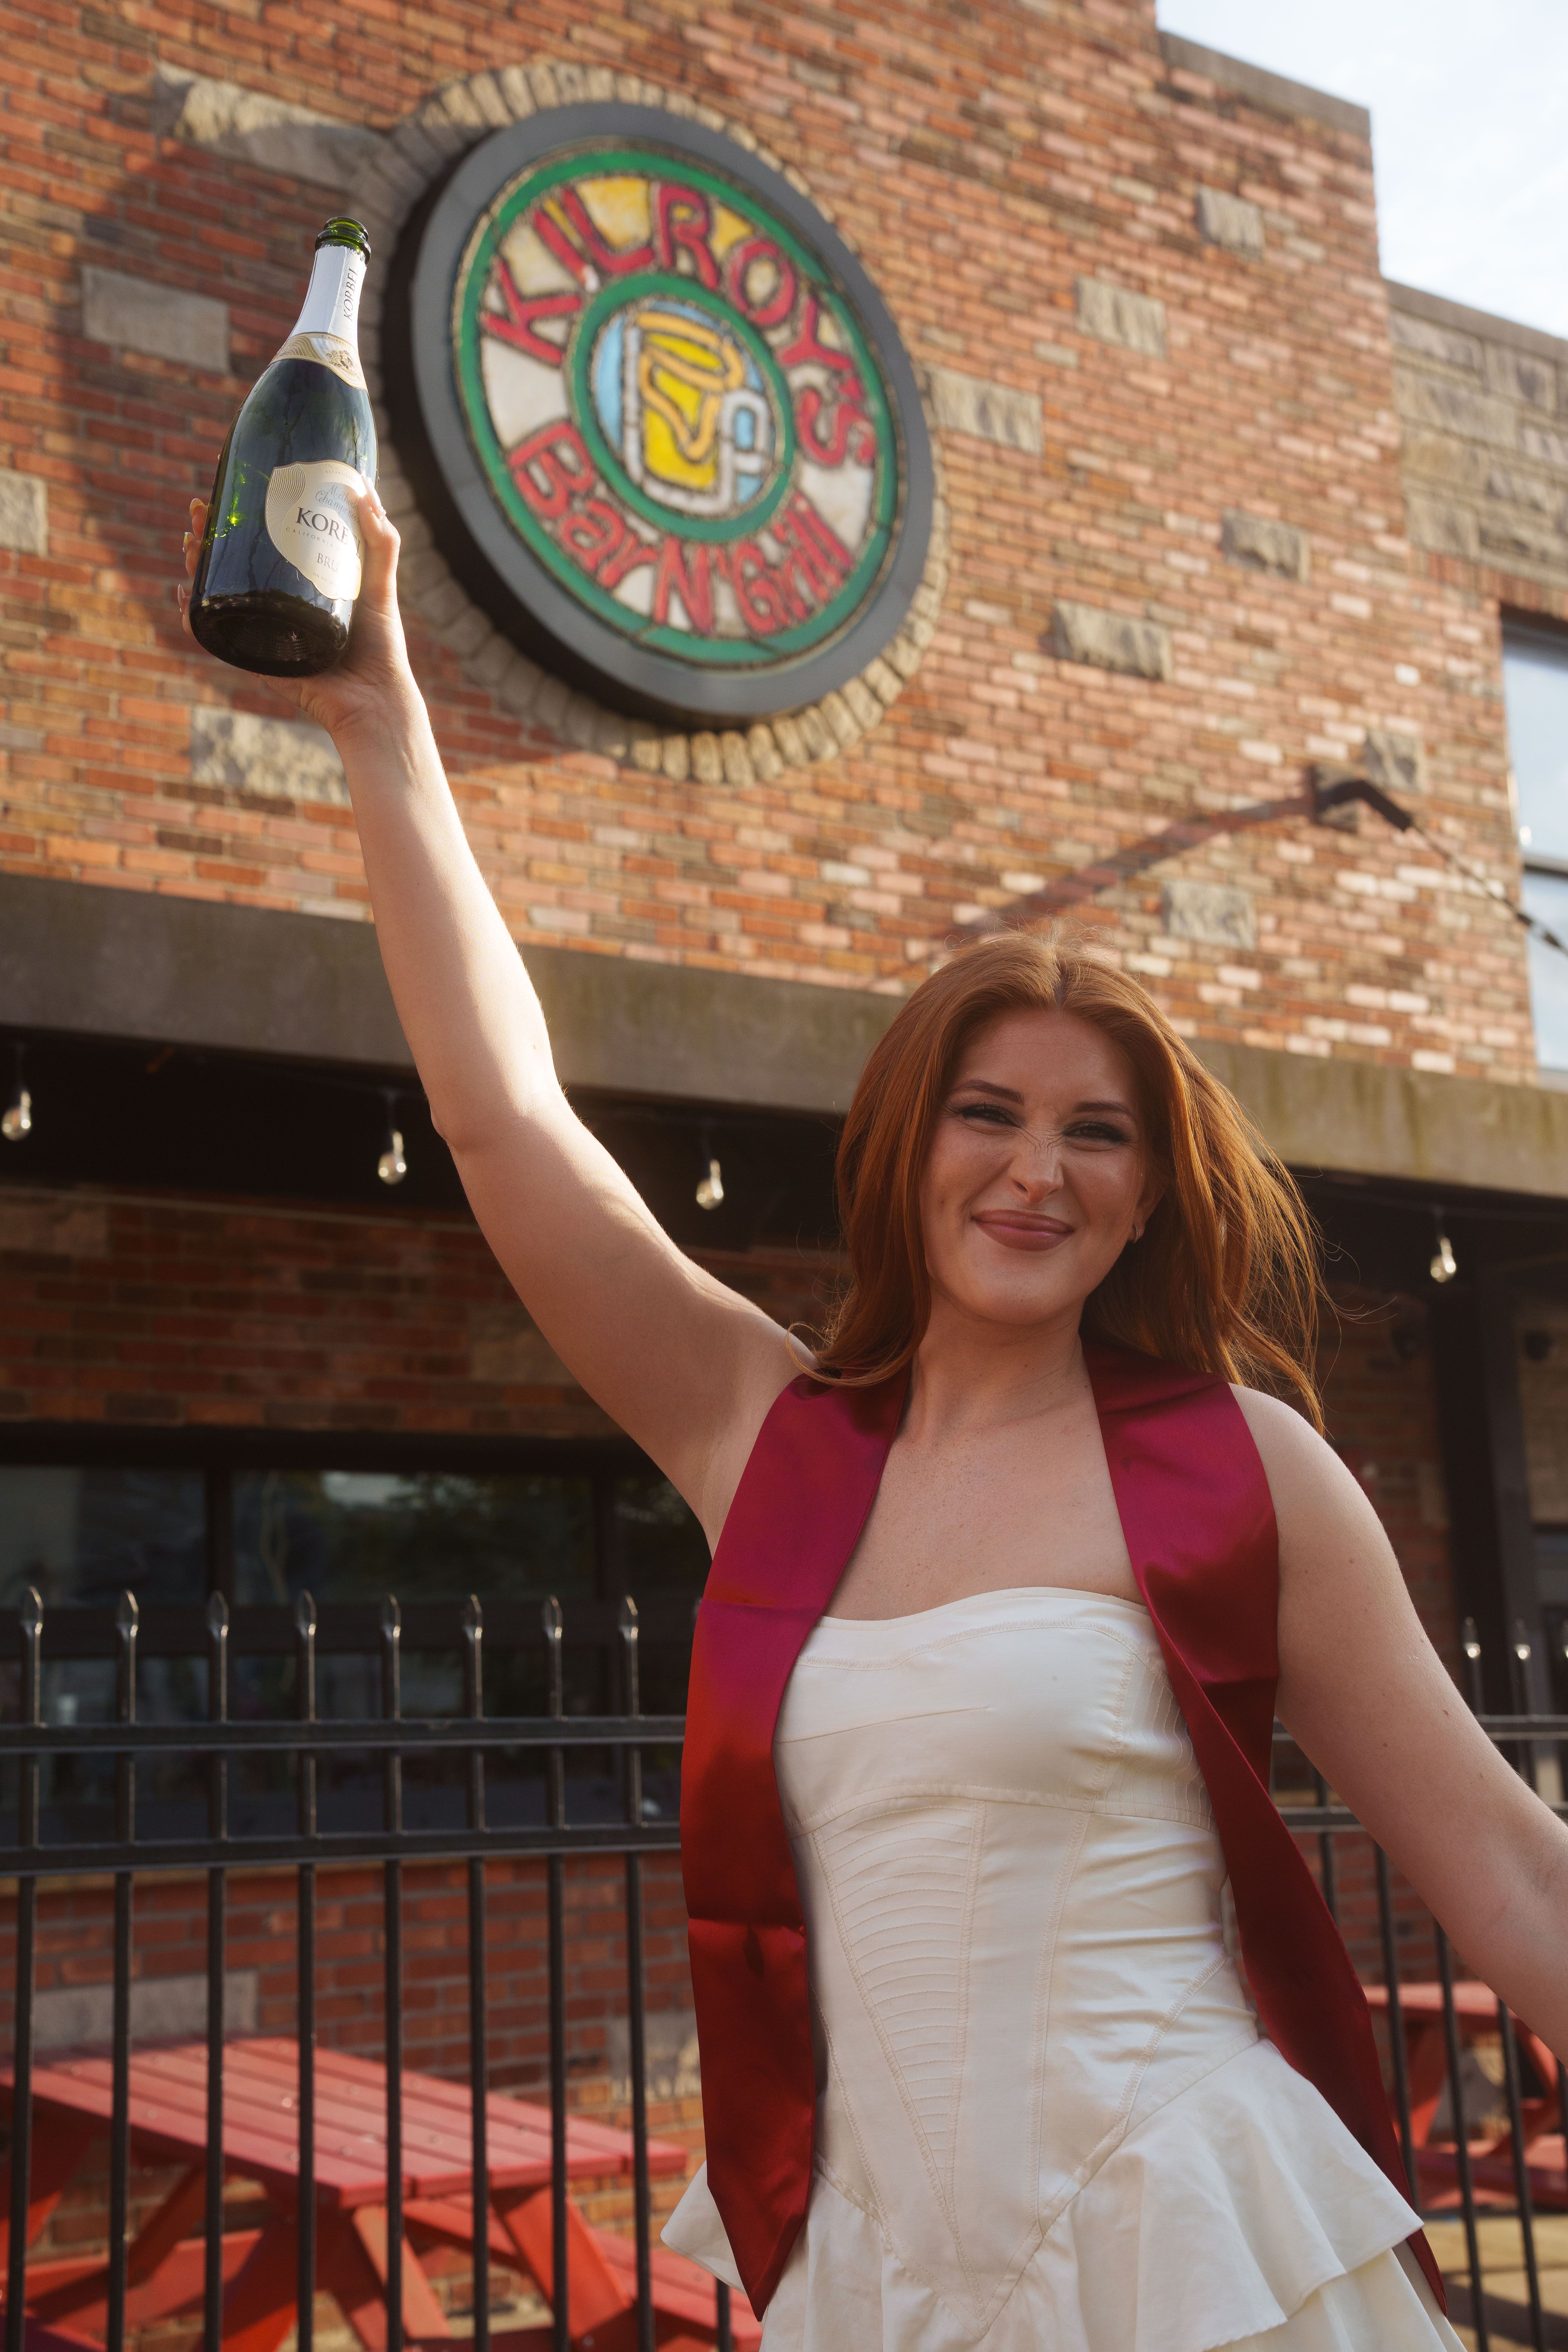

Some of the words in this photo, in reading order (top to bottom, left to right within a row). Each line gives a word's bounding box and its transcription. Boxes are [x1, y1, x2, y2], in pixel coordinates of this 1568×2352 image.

[344, 268, 358, 321] KORBEL
[481, 184, 876, 466] KILROY'S
[286, 527, 333, 548] CALIFORNIA
[508, 423, 658, 588] Bar
[732, 490, 857, 635] Grill
[317, 552, 338, 572] BRU
